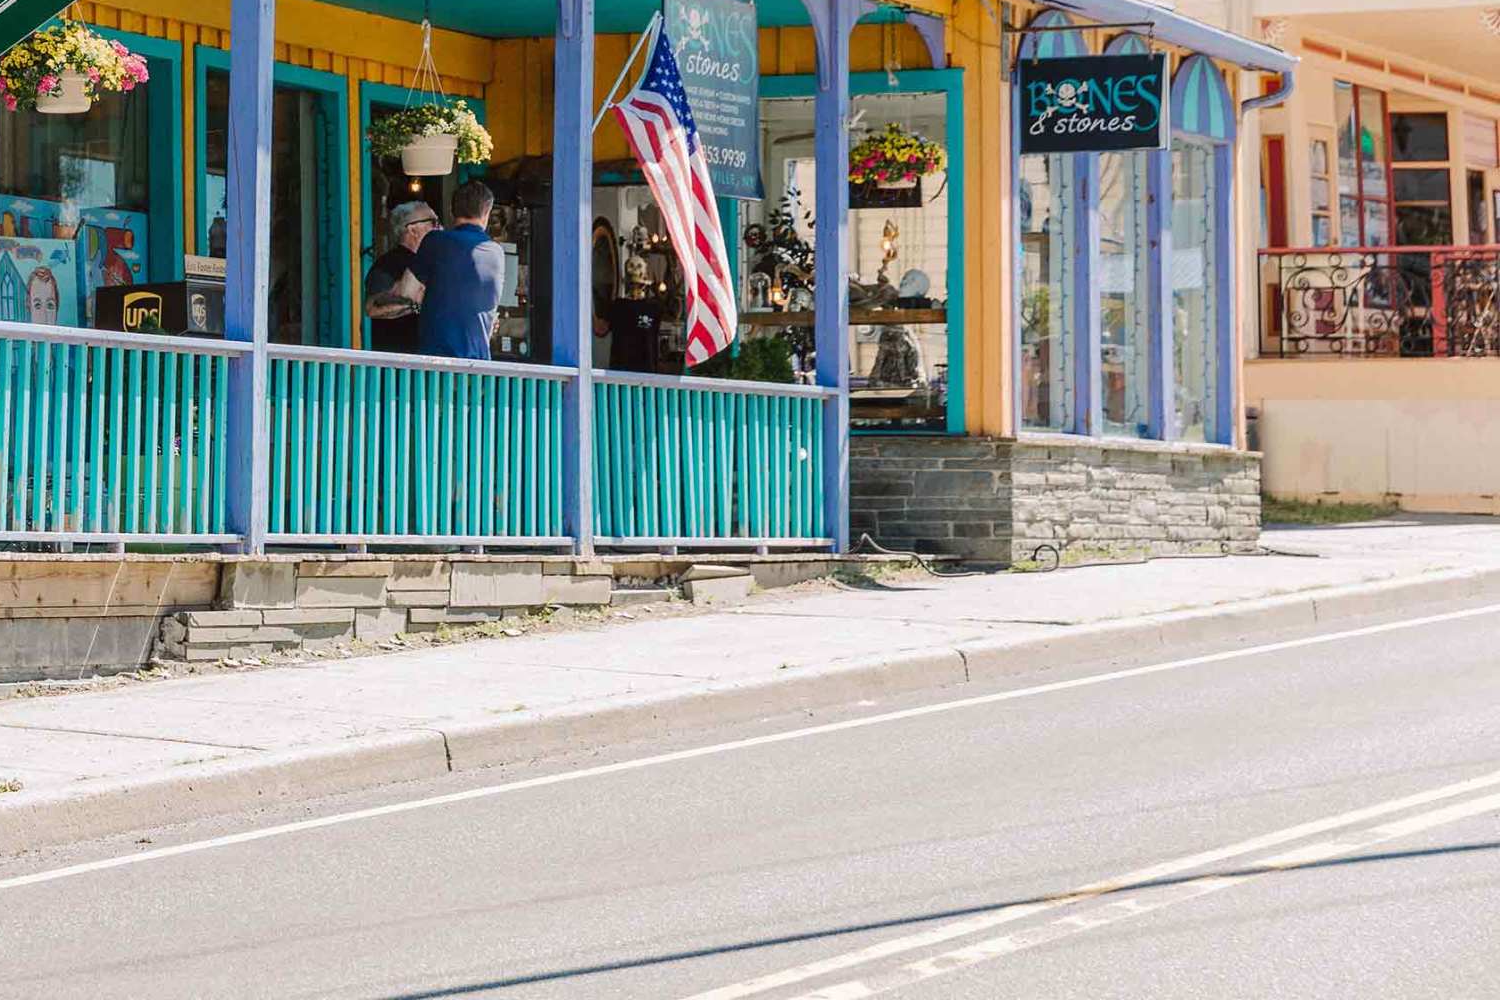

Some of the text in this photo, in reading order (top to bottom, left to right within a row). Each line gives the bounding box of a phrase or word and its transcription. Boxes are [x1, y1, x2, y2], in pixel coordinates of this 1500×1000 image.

[686, 51, 741, 81] stones
[1027, 74, 1161, 133] BONES
[1029, 111, 1137, 136] & stones
